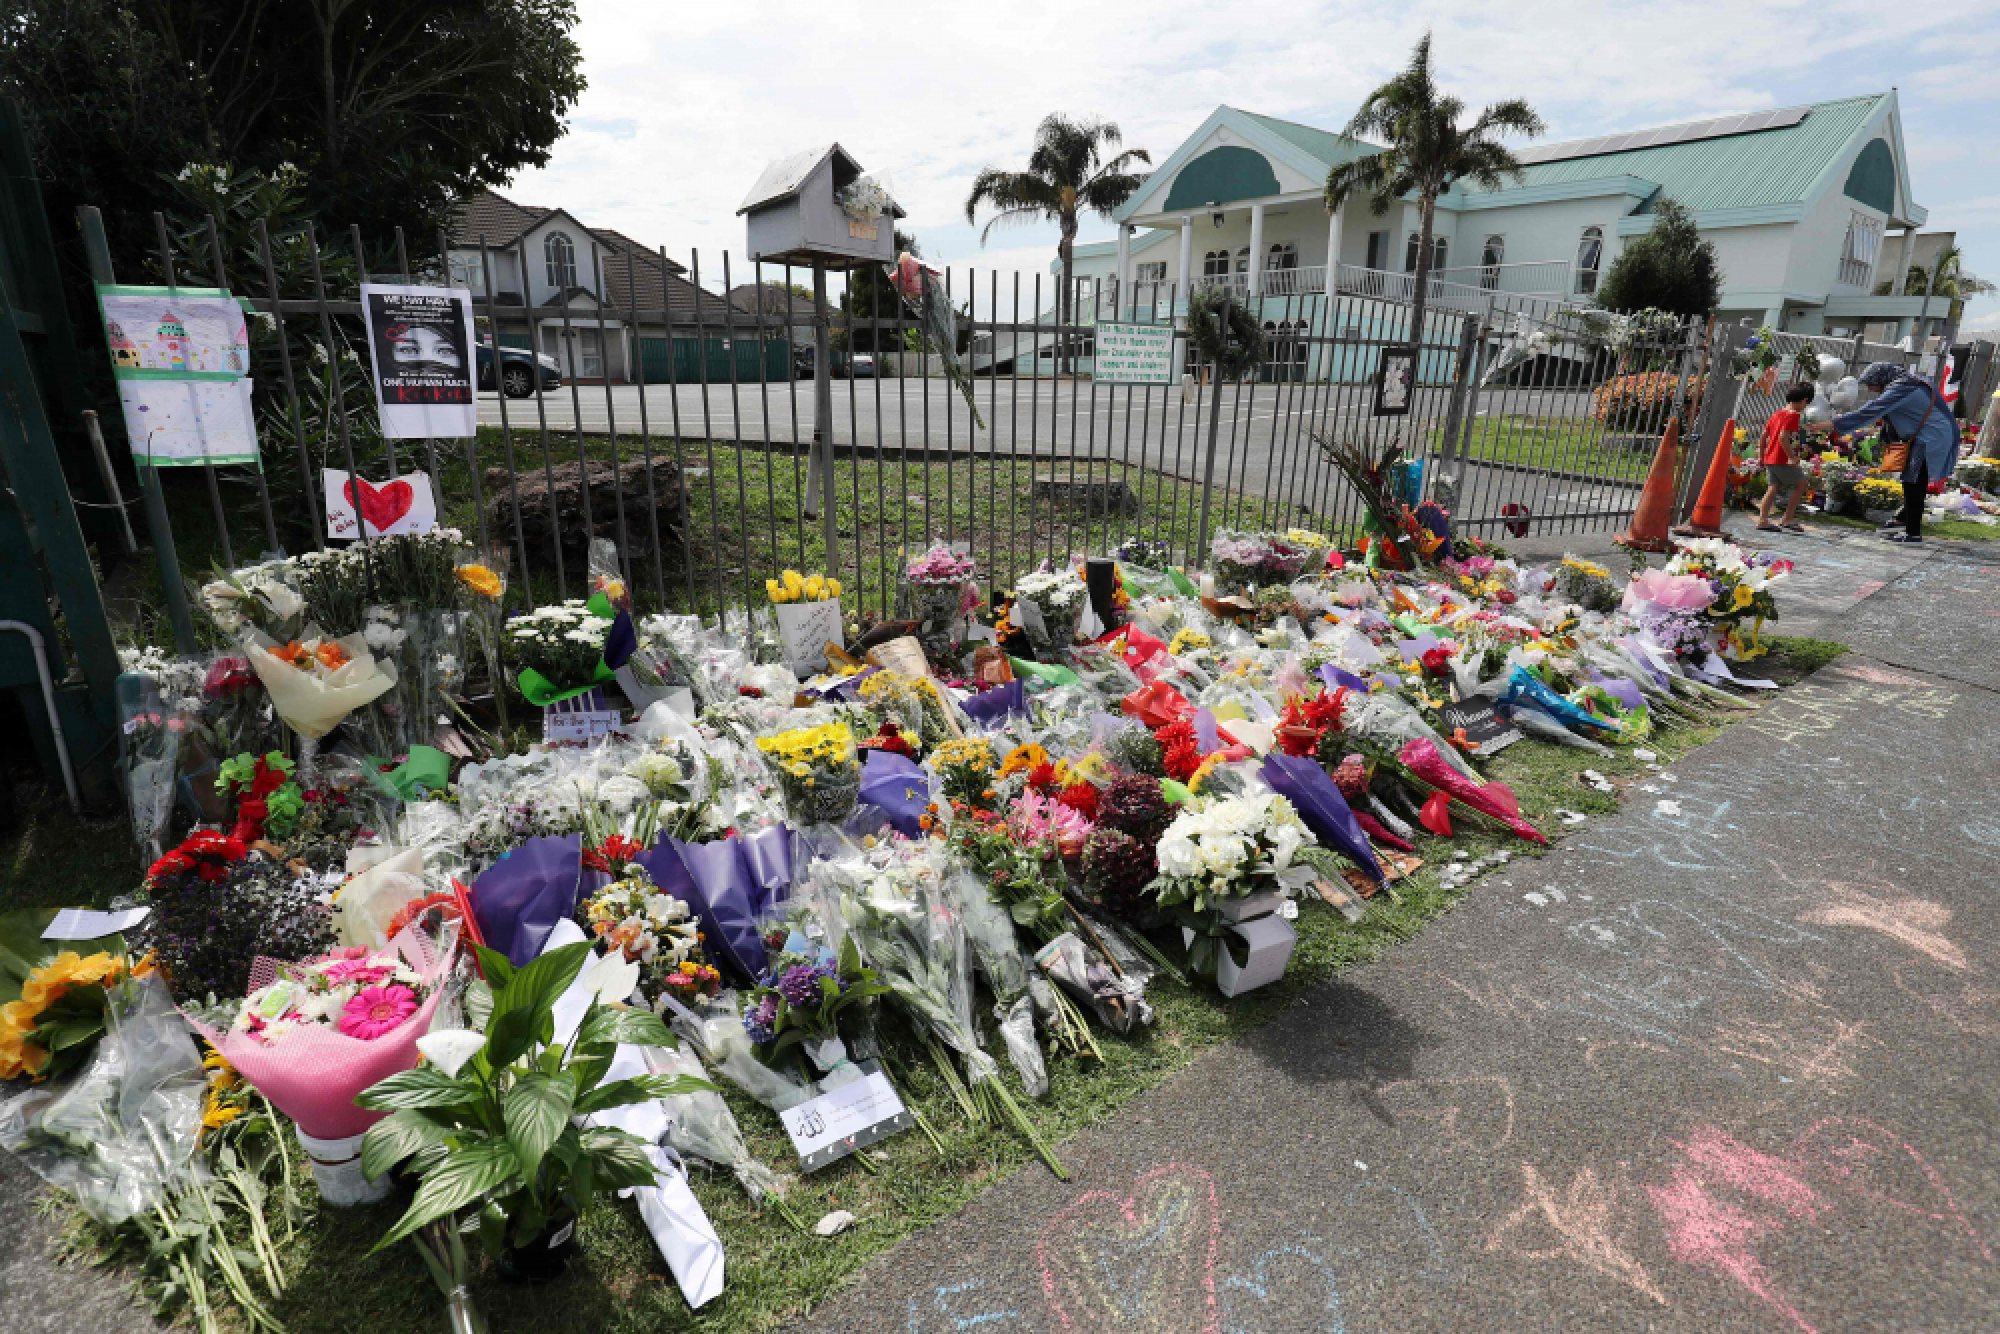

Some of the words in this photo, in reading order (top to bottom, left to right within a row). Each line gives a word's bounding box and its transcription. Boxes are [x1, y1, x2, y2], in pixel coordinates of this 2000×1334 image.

[383, 295, 401, 304] WE
[403, 296, 423, 304] MAY
[425, 297, 453, 306] HAVE
[1099, 324, 1111, 333] The
[1113, 325, 1135, 335] Muslim
[1137, 327, 1171, 338] Community
[1095, 347, 1109, 356] New
[1111, 348, 1142, 358] Zealander
[383, 377, 405, 387] ONE
[405, 378, 443, 387] HUMAN
